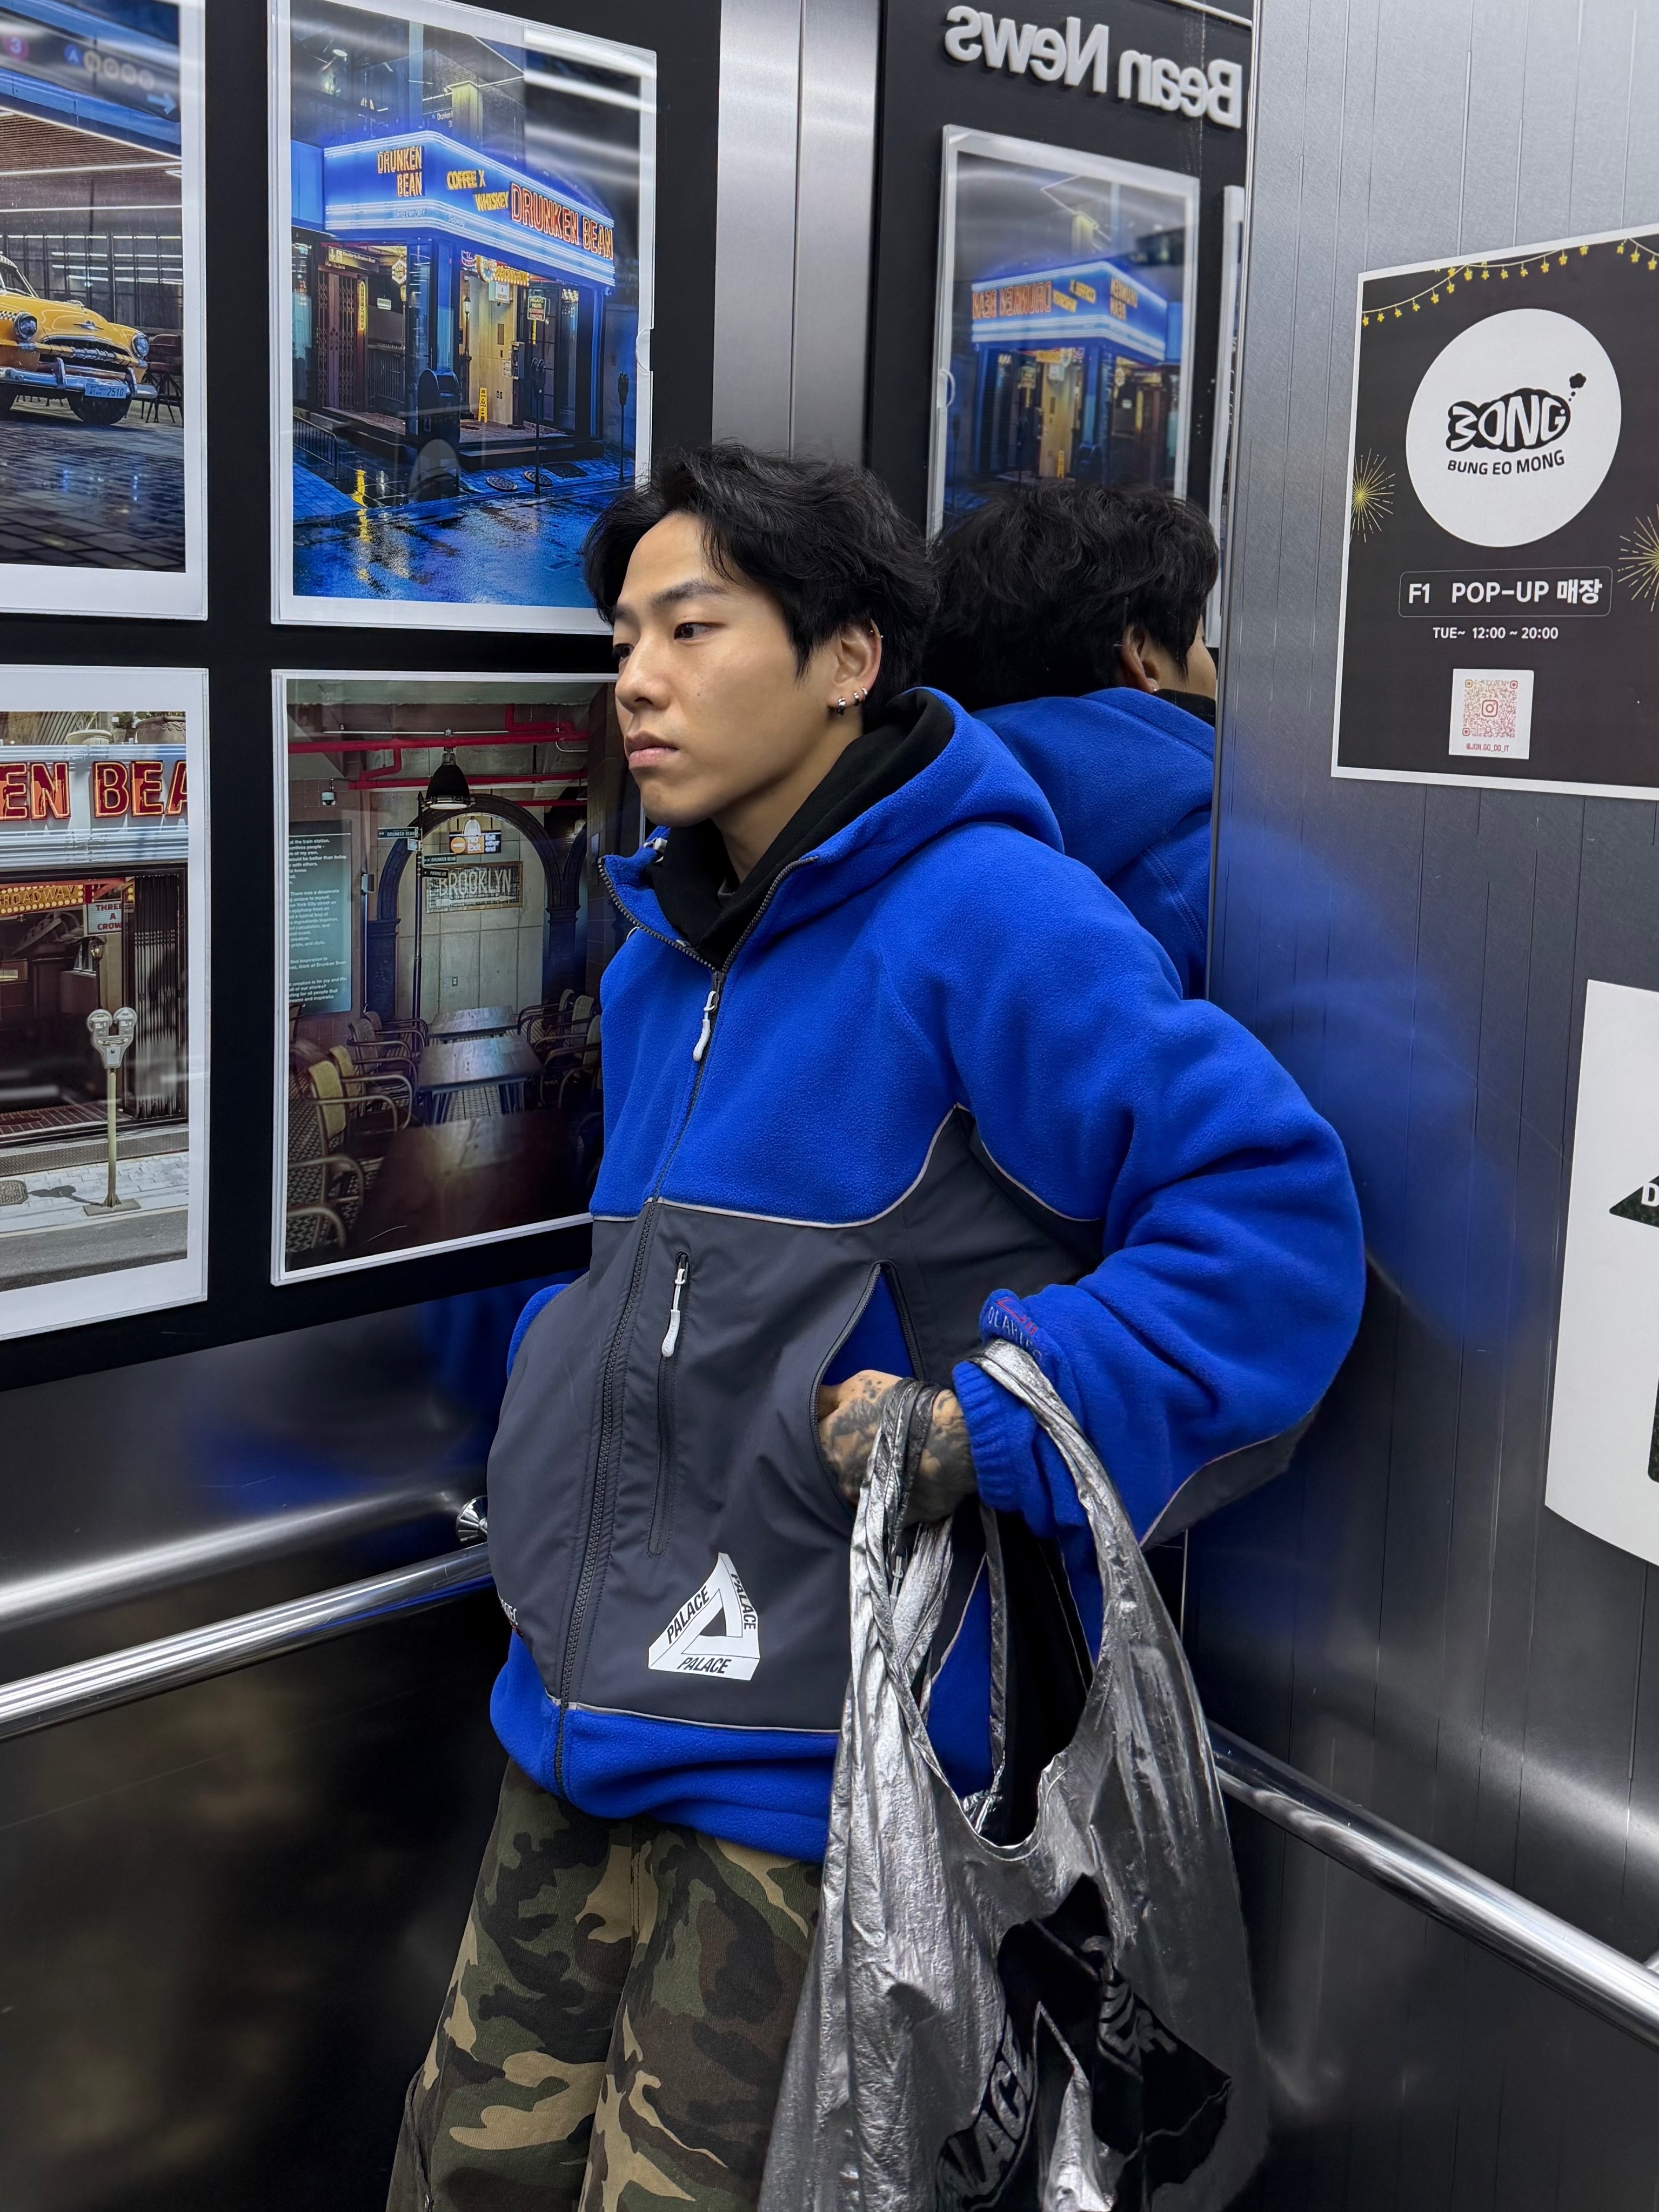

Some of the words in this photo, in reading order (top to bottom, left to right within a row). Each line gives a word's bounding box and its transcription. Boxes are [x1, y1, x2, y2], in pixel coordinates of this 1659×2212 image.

[377, 146, 422, 173] DRUNKEN
[397, 171, 422, 197] BEAN
[447, 170, 477, 190] COFFEE
[478, 169, 486, 187] X
[473, 191, 509, 211] WHISKEY
[511, 182, 579, 246] DRUNKEN
[583, 216, 614, 260] BEAN
[107, 387, 124, 397] 2510
[1448, 459, 1488, 475] BUNG
[1493, 461, 1512, 475] EO
[1516, 450, 1565, 474] MONG
[1408, 583, 1430, 604] F1
[1452, 581, 1549, 604] POP-UP
[1556, 579, 1603, 604] 매장
[1472, 627, 1506, 639] 12:00
[1521, 627, 1559, 639] 20:00
[439, 868, 511, 897] BROOKLYN
[0, 885, 75, 906] ROADWAY
[731, 1573, 757, 1630] PALACE
[667, 1585, 710, 1644] PALACE
[677, 1657, 732, 1674] PALACE
